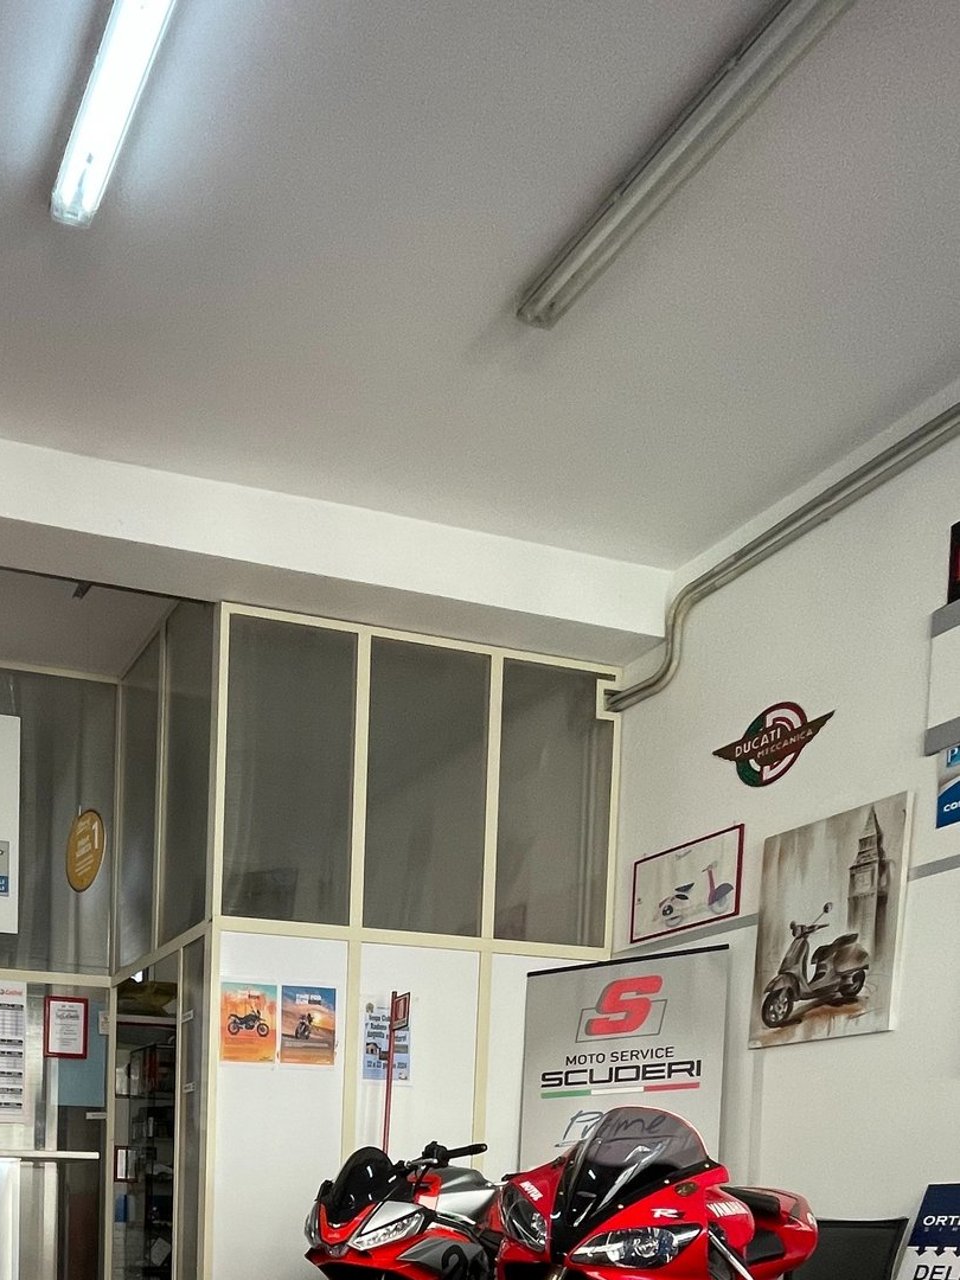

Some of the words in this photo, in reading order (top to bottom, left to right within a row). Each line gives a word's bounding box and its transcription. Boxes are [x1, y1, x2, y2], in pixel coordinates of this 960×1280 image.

[735, 727, 781, 758] DUCATI
[757, 728, 813, 759] MECCANICA
[565, 1052, 606, 1067] MOTO
[610, 1046, 676, 1063] SERVICE
[541, 1060, 702, 1088] SCUDERI
[922, 1215, 960, 1227] ORT
